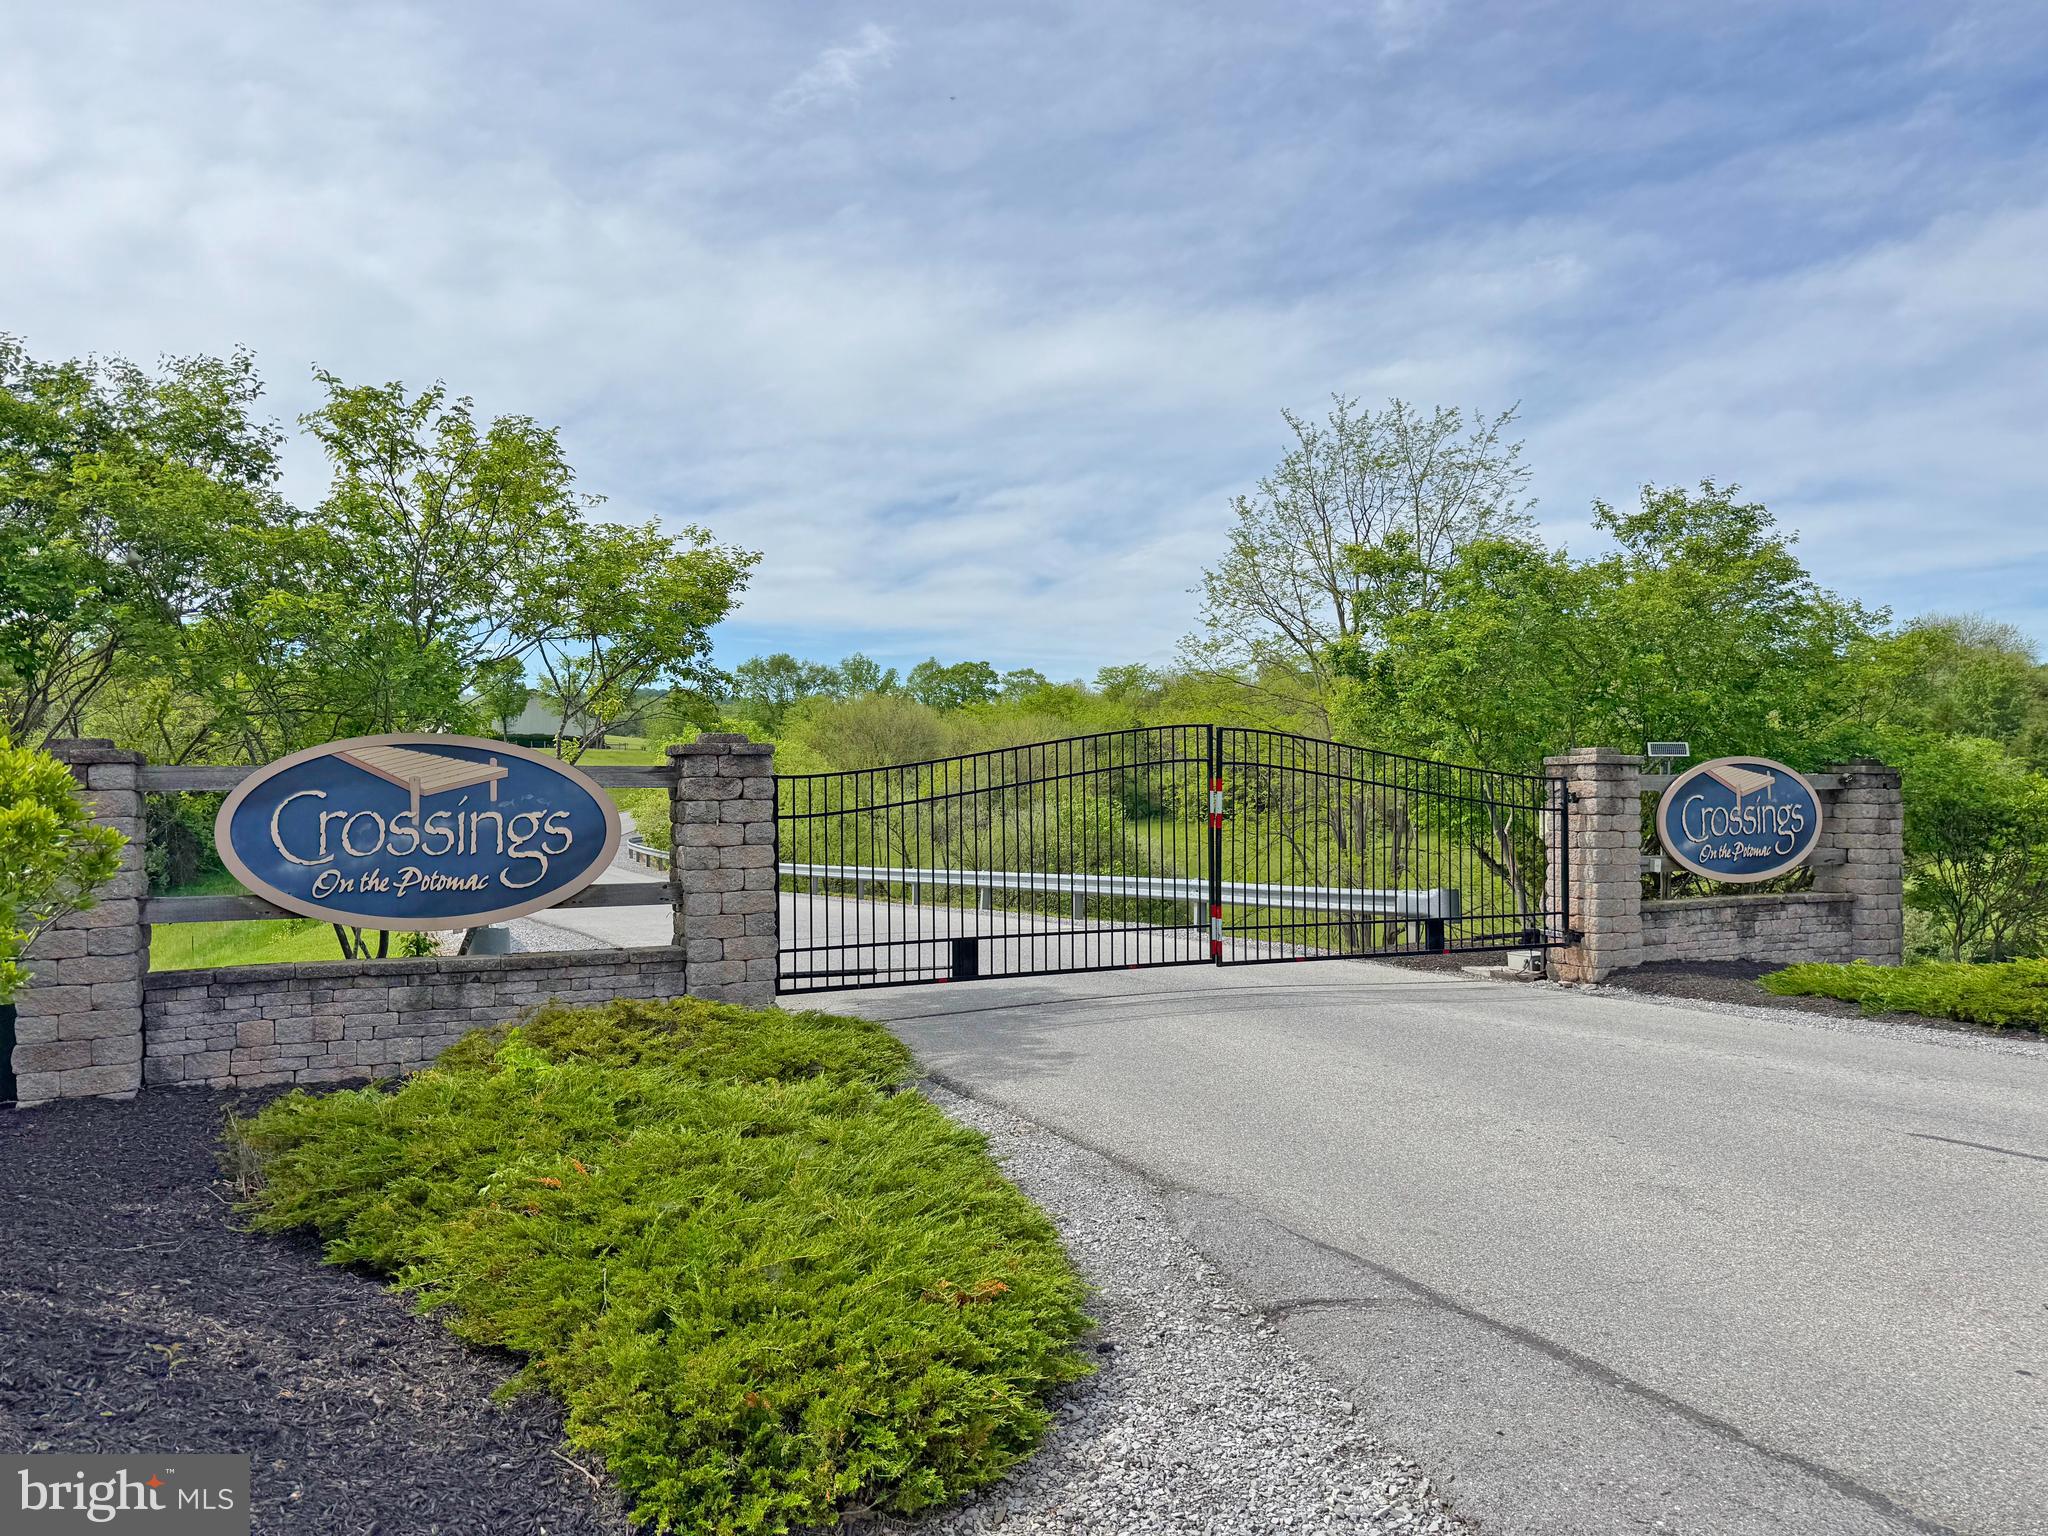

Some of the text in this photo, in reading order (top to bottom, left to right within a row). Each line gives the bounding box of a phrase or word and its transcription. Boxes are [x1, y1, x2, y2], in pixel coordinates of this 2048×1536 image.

[270, 789, 574, 889] Crossings
[1682, 794, 1805, 855] Crossings
[1699, 841, 1772, 864] On the Potomac
[311, 866, 490, 899] On the Potomac
